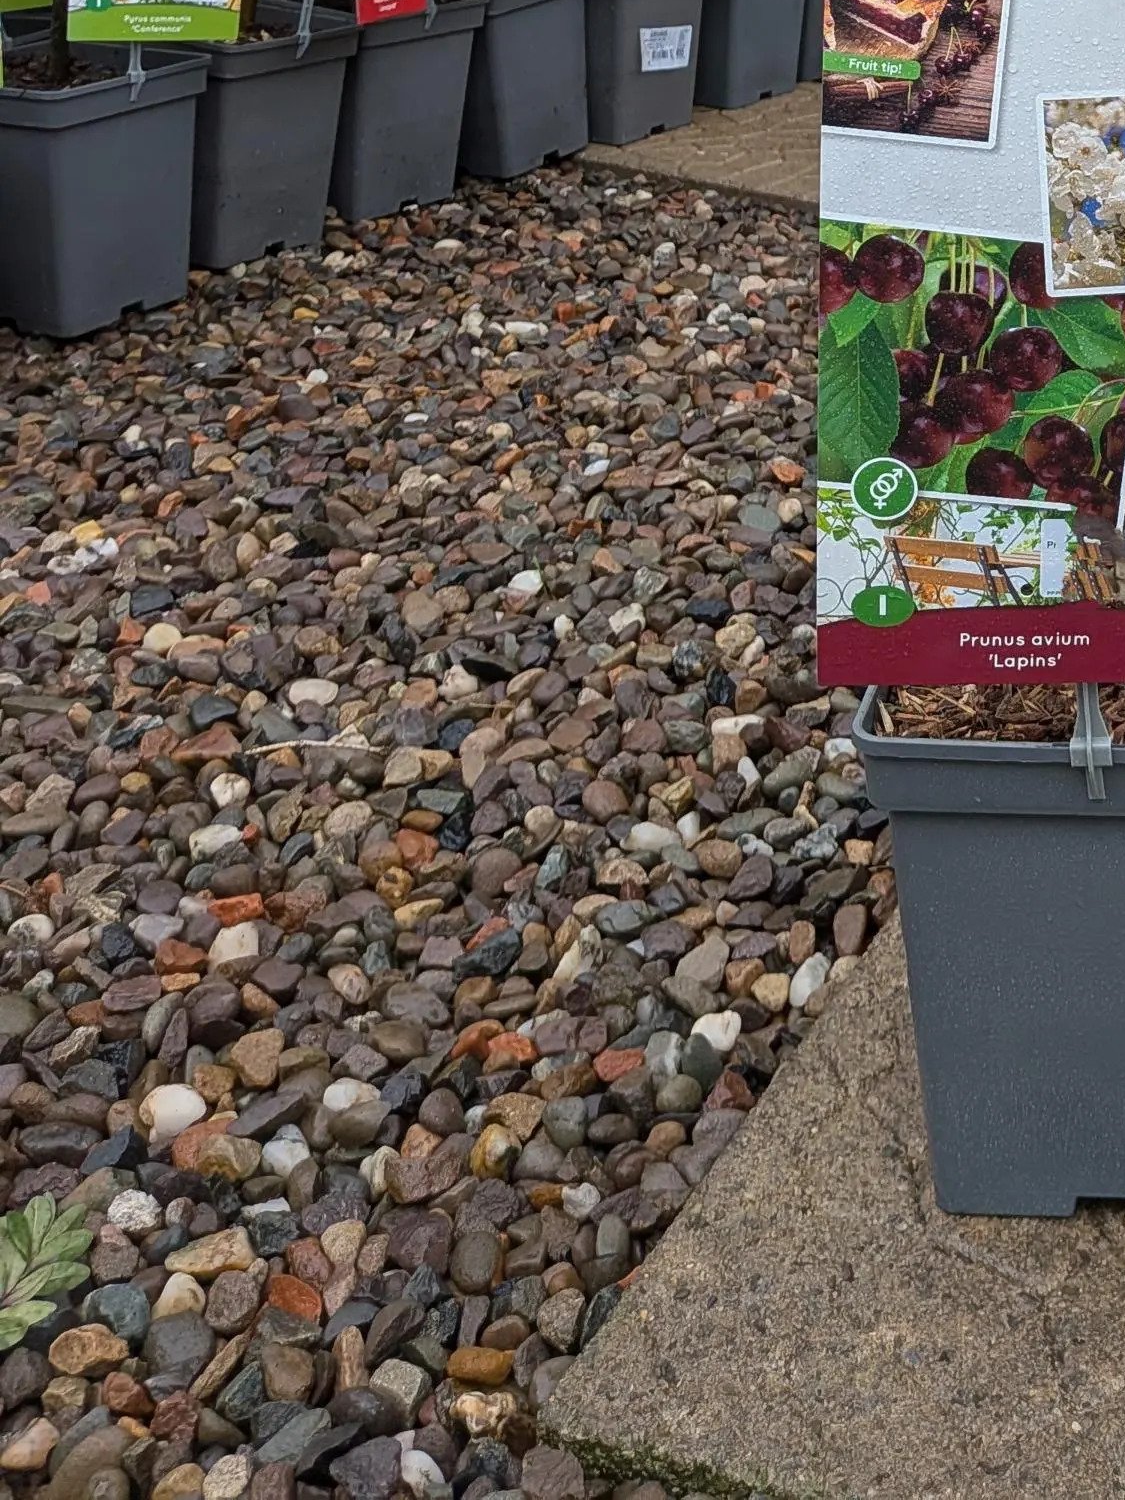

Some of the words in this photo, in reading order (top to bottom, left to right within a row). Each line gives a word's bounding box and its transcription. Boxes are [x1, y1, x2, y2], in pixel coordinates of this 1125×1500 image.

[124, 14, 148, 23] Pyrus
[848, 58, 878, 71] Fruit
[881, 62, 902, 75] tip!
[960, 632, 1025, 647] Prunus
[1031, 632, 1090, 646] avium
[989, 653, 1061, 670] 'Lapins'
